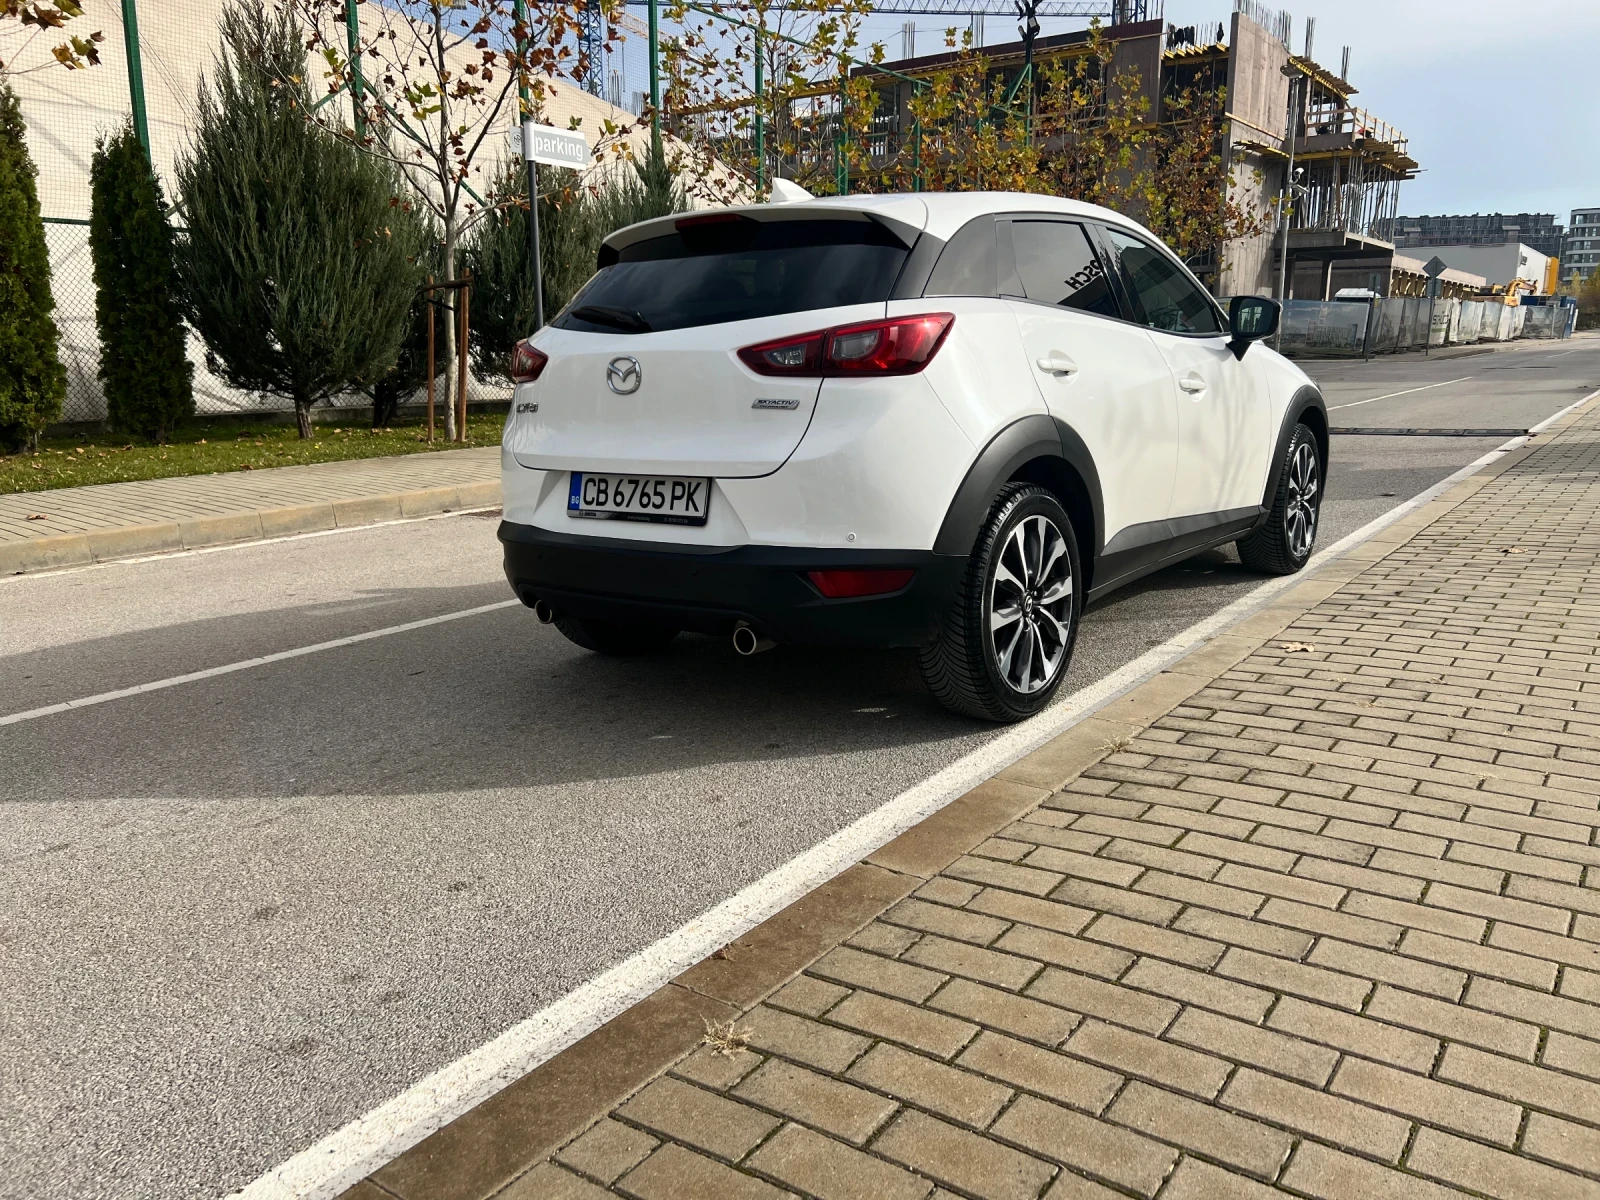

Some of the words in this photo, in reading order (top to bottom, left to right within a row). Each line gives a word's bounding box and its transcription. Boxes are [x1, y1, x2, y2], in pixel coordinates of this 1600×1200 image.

[535, 136, 583, 161] parking
[571, 495, 580, 504] BG
[583, 478, 609, 507] CB
[613, 479, 666, 510] 6765
[669, 481, 702, 512] PK
